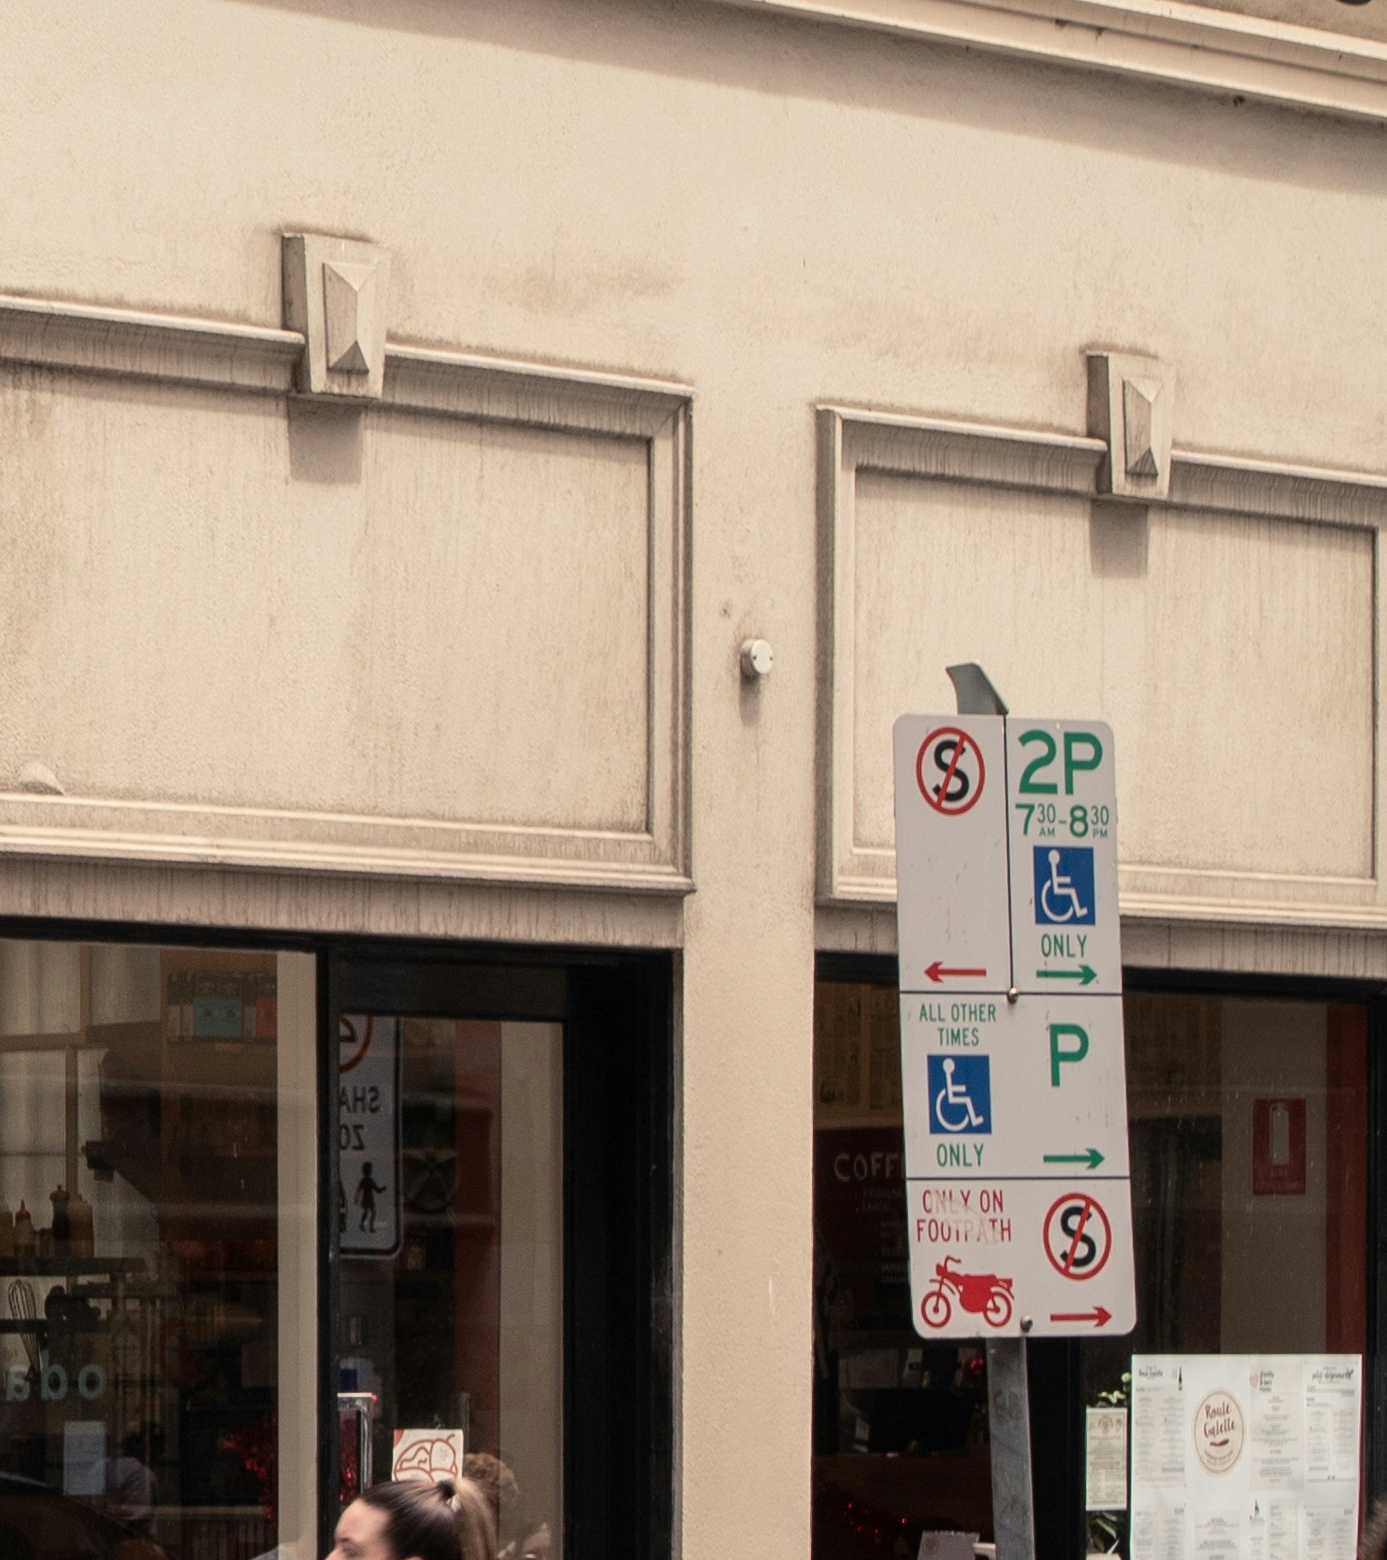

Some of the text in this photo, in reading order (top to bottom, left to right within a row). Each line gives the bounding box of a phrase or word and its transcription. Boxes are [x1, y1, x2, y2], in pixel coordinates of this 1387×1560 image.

[1017, 730, 1103, 796] 2P
[1041, 934, 1087, 958] ONLY
[919, 1003, 996, 1022] ALL OTHER
[937, 1027, 979, 1047] TIMES
[1049, 1023, 1090, 1088] P
[936, 1143, 984, 1167] ONLY
[922, 1189, 971, 1213] ONLY
[979, 1189, 1004, 1213] ON
[916, 1219, 1012, 1242] FOOTPATH
